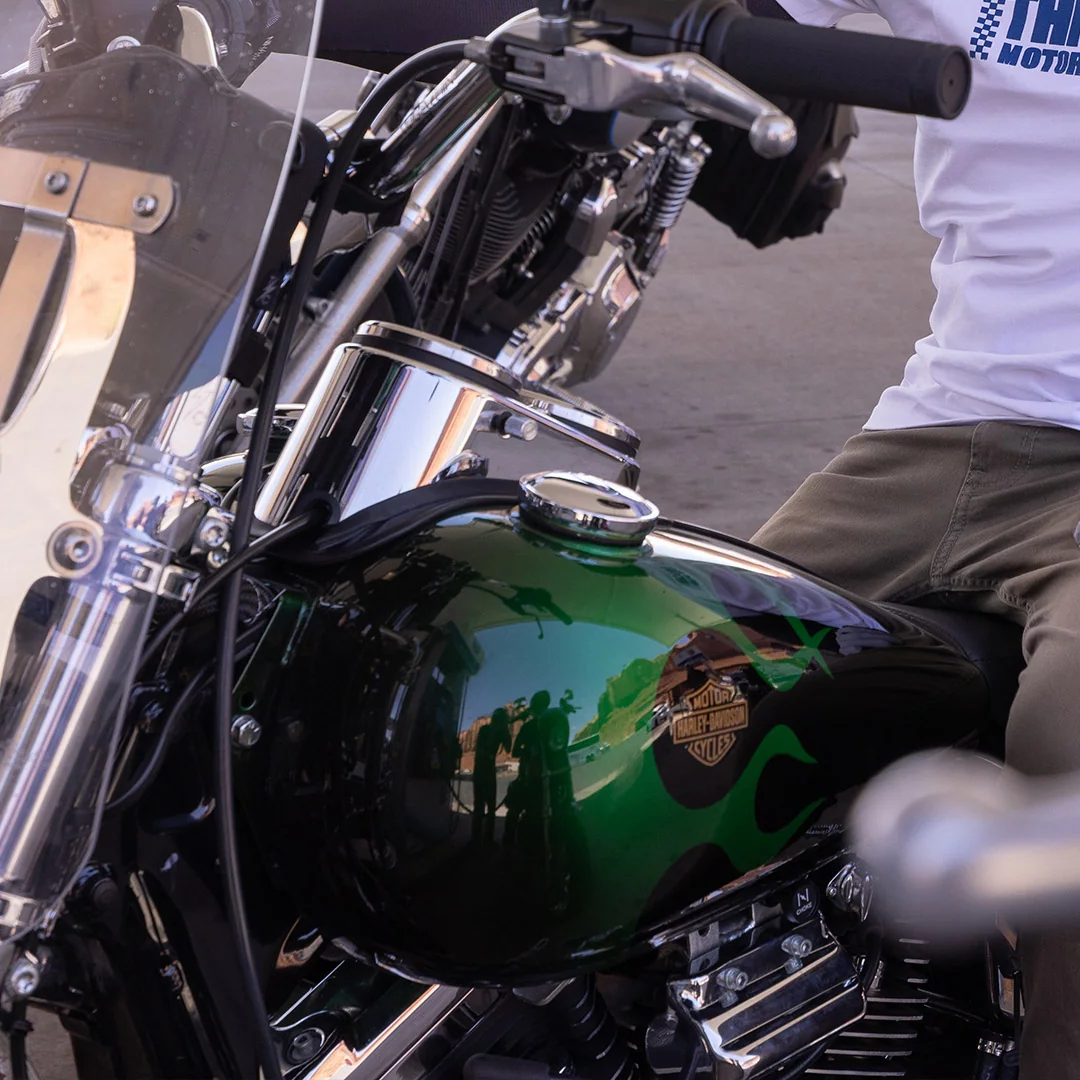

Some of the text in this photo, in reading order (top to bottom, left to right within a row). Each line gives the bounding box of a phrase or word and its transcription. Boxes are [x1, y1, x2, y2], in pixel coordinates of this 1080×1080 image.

[693, 685, 730, 711] MOTOR
[677, 706, 745, 738] HARLEY-DAVIDSON
[693, 734, 731, 761] CYCLES
